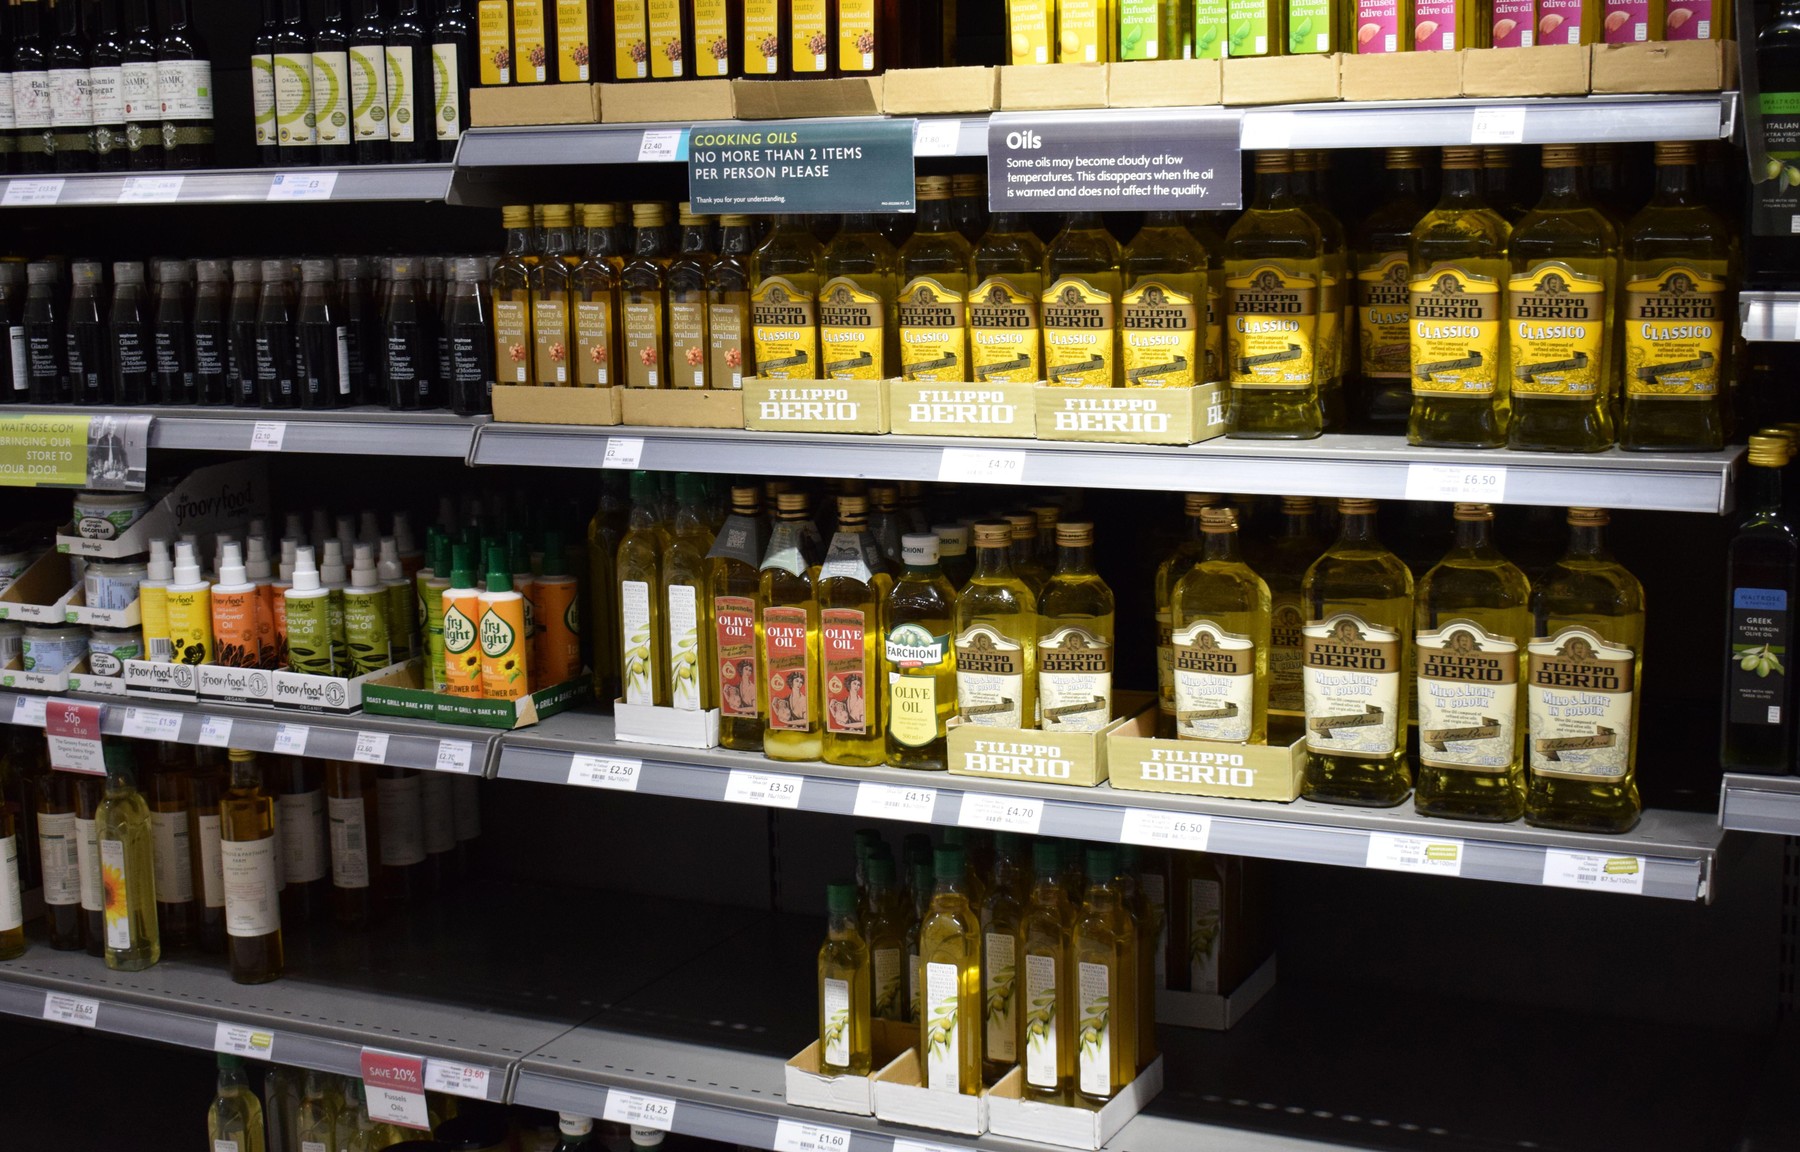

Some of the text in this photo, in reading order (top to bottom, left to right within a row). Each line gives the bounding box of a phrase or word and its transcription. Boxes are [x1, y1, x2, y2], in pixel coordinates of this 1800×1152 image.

[1123, 6, 1155, 14] infused
[1292, 8, 1312, 16] olive
[1360, 8, 1395, 18] olive oil
[1418, 6, 1453, 15] olive oil
[1496, 4, 1532, 13] olive oil
[481, 11, 497, 19] Rich
[1123, 16, 1142, 24] olive
[1231, 11, 1252, 19] olive
[481, 20, 498, 28] nutty
[1476, 122, 1487, 130] £3
[695, 132, 797, 147] COOKING OILS
[1007, 130, 1041, 149] Oils
[695, 147, 862, 163] NO MORE THAN 2 ITEMS
[1007, 155, 1182, 169] Some oils may become cloudy at low
[696, 166, 829, 179] PER PERSON PLEASE
[1008, 169, 1213, 184] temperatures. This disappears when the oil
[308, 180, 319, 189] £3
[1007, 184, 1208, 197] is warmed and does not affect the quality.
[747, 195, 786, 203] understanding.
[1239, 294, 1298, 302] FILIPPO
[1420, 298, 1478, 307] FILIPPO
[1522, 298, 1584, 307] FILIPPO
[1235, 302, 1302, 313] BERIO
[1416, 306, 1482, 319] BERIO
[1517, 306, 1588, 319] BERIO
[498, 311, 516, 319] Nutty
[754, 314, 806, 325] BERIO
[1044, 317, 1104, 327] BERIO
[1236, 318, 1299, 333] CLASSICO
[498, 328, 521, 336] walnut
[758, 329, 800, 341] CLASSICO
[1417, 322, 1480, 339] CLASSICO
[1519, 322, 1585, 339] CLASSICO
[904, 330, 949, 343] CLASSICO
[976, 332, 1023, 344] CLASSICO
[768, 389, 847, 400] FILIPPO
[918, 390, 1004, 403] FILIPPO
[1065, 399, 1157, 411] FILIPPO
[759, 402, 857, 421] BERIO
[1, 423, 73, 432] WAITROSE.COM
[1054, 412, 1168, 432] BERIO
[0, 437, 71, 447] BRINGING OUR
[27, 452, 72, 461] STORE TO
[0, 464, 57, 475] YOUR DOOR
[989, 460, 1016, 469] £4.70
[1464, 475, 1496, 485] £6.50
[296, 618, 317, 627] Virgin
[447, 616, 462, 630] fry
[484, 619, 500, 634] fry
[719, 616, 752, 627] OLIVE
[302, 626, 313, 634] Oil
[726, 626, 746, 636] OIL
[768, 627, 804, 638] OLIVE
[826, 629, 862, 640] OLIVE
[444, 629, 470, 646] light
[481, 633, 508, 650] light
[775, 638, 796, 648] OIL
[833, 640, 854, 649] OIL
[888, 646, 937, 658] FARCHIONI
[1349, 673, 1377, 687] LIGHT
[895, 687, 930, 699] OLIVE
[1334, 686, 1372, 696] COLOUR
[902, 701, 923, 713] OIL
[1450, 697, 1489, 708] COLOUR
[477, 708, 491, 716] BAKE
[64, 712, 80, 726] 50p
[159, 718, 177, 727] £1.99
[201, 726, 216, 735] £1.99
[975, 740, 1061, 758] FILIPPO
[1151, 749, 1243, 767] FILIPPO
[610, 766, 633, 775] £2.50
[964, 753, 1070, 779] BERIO
[1139, 761, 1254, 788] BERIO
[769, 783, 794, 793] £3.50
[905, 792, 931, 803] £4.15
[1006, 806, 1033, 818] £4.70
[1174, 822, 1202, 833] £6.50
[369, 1067, 416, 1082] SAVE 20%
[464, 1068, 484, 1079] £3.60
[384, 1092, 406, 1102] Fussels
[391, 1104, 404, 1112] Oils
[645, 1103, 668, 1115] £4.25
[819, 1134, 844, 1145] £1.60
